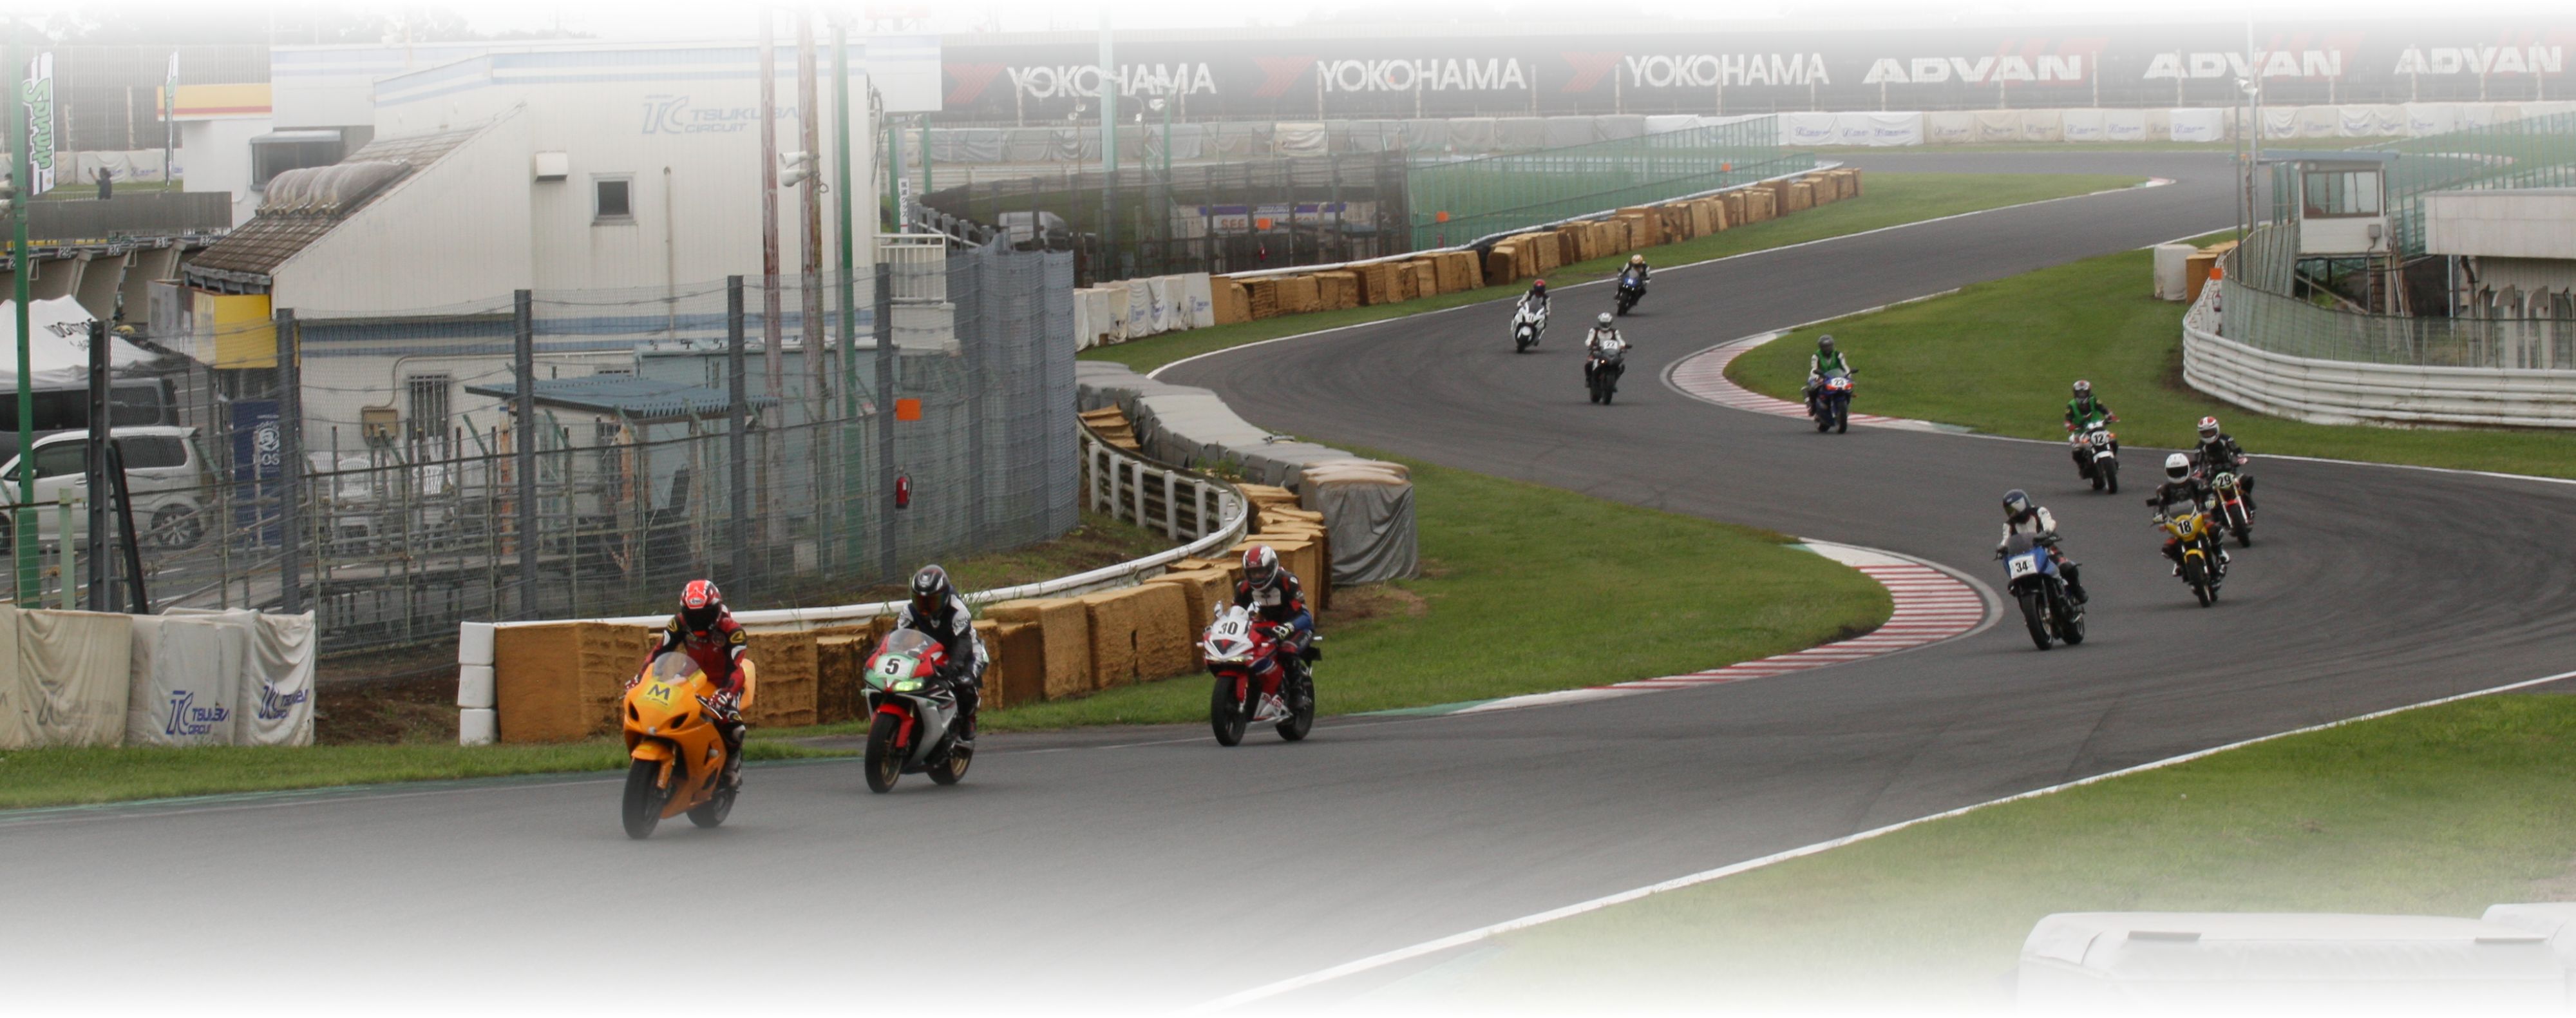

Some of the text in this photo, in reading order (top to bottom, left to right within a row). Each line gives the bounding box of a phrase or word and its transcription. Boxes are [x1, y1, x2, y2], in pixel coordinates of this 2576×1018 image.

[2143, 50, 2341, 79] ADVAN
[2394, 46, 2562, 74] ADVAN
[1317, 58, 1527, 92] YOKOHAMA
[1625, 53, 1830, 87] YOKOHAMA
[1862, 55, 2081, 84] ADVAN
[685, 122, 749, 133] CIRCUIT
[60, 247, 71, 257] 29
[2094, 434, 2104, 444] 12
[2217, 475, 2232, 487] 29
[2178, 520, 2192, 534] 18
[2015, 561, 2029, 573] 34
[1218, 622, 1238, 635] 30
[885, 658, 900, 675] 5
[647, 684, 671, 700] M
